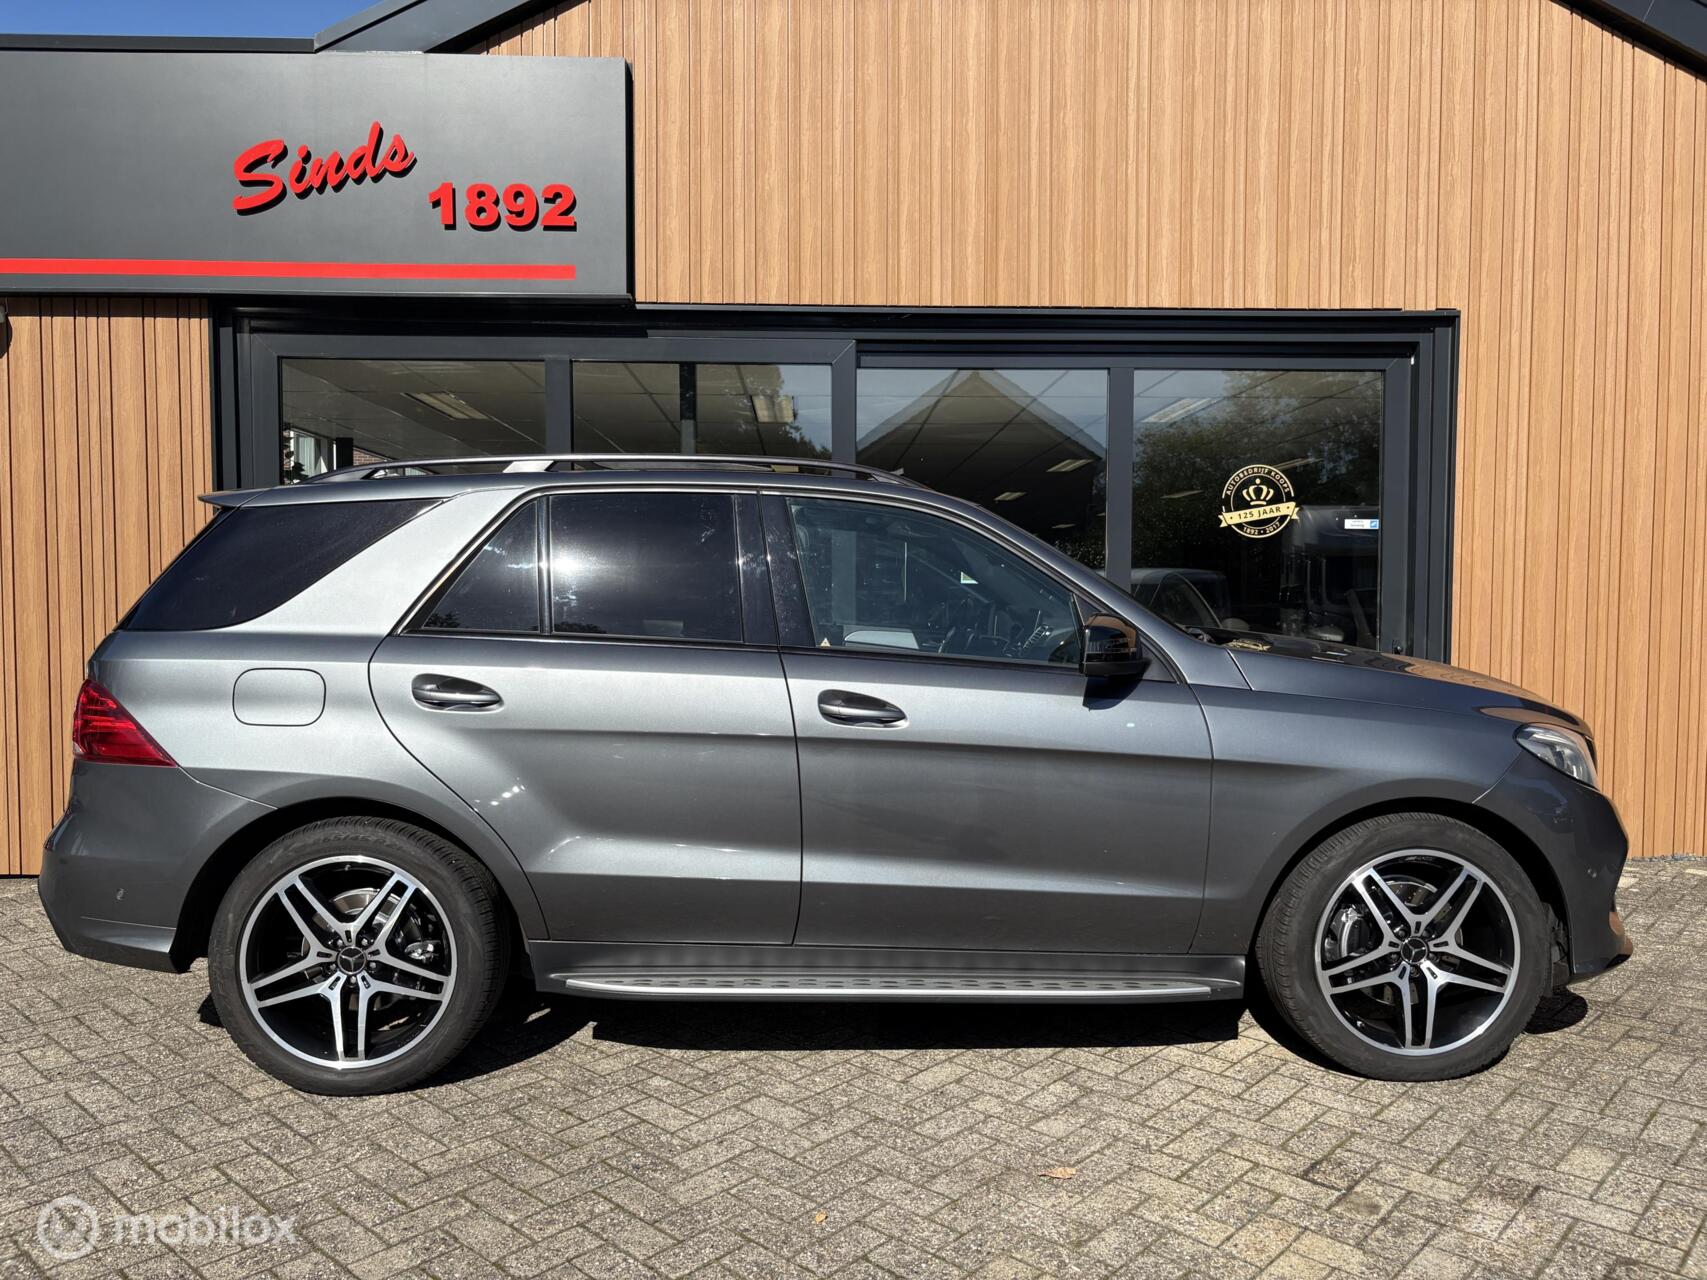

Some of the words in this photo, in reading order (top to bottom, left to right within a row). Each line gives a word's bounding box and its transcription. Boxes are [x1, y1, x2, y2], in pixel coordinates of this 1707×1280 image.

[232, 121, 416, 215] Sinds
[428, 182, 577, 231] 1892
[1226, 467, 1269, 496] AUTOBEDRIJF
[1270, 471, 1290, 494] KOOPS
[1238, 511, 1254, 520] 125
[1258, 506, 1281, 517] JAAR
[1243, 526, 1259, 535] 1892
[1265, 521, 1281, 534] 2017
